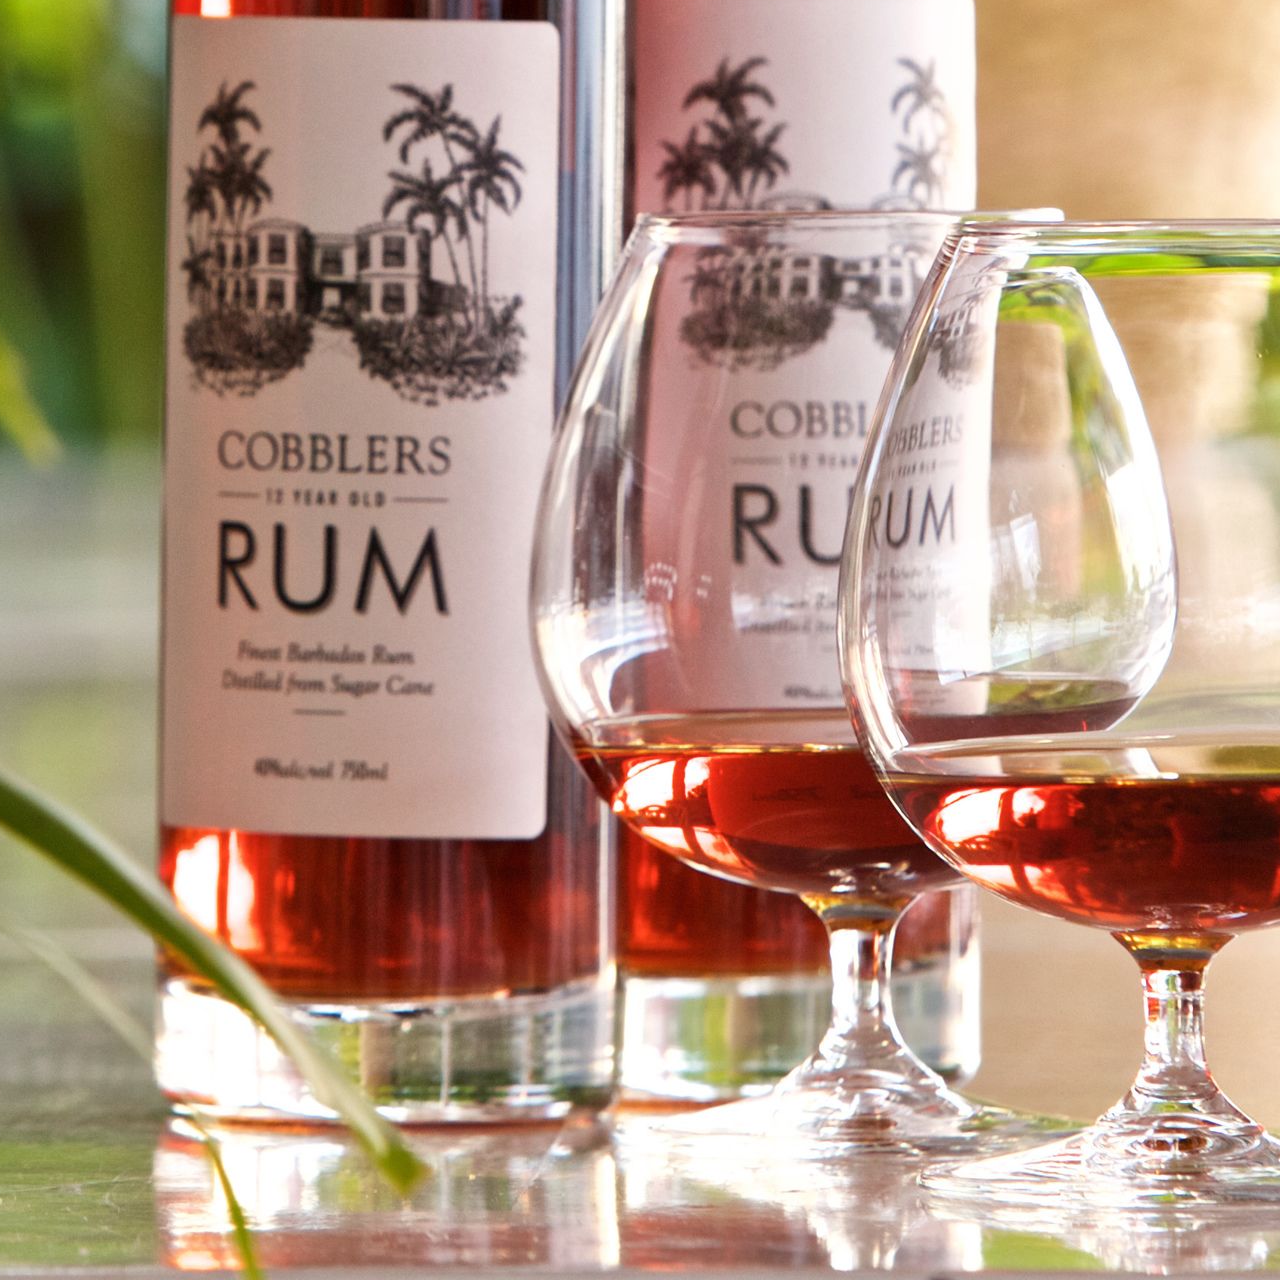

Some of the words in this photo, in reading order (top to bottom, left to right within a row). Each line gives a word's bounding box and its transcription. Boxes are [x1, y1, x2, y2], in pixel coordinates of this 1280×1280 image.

[730, 399, 867, 439] COBBL
[887, 413, 963, 457] OBBLERS
[217, 430, 452, 476] COBBLERS
[266, 488, 284, 505] 12
[293, 489, 337, 507] YEAR
[349, 491, 385, 507] OLD
[732, 483, 856, 567] RU
[218, 520, 449, 617] RUM
[372, 644, 415, 664] Rum
[385, 675, 434, 696] Cane
